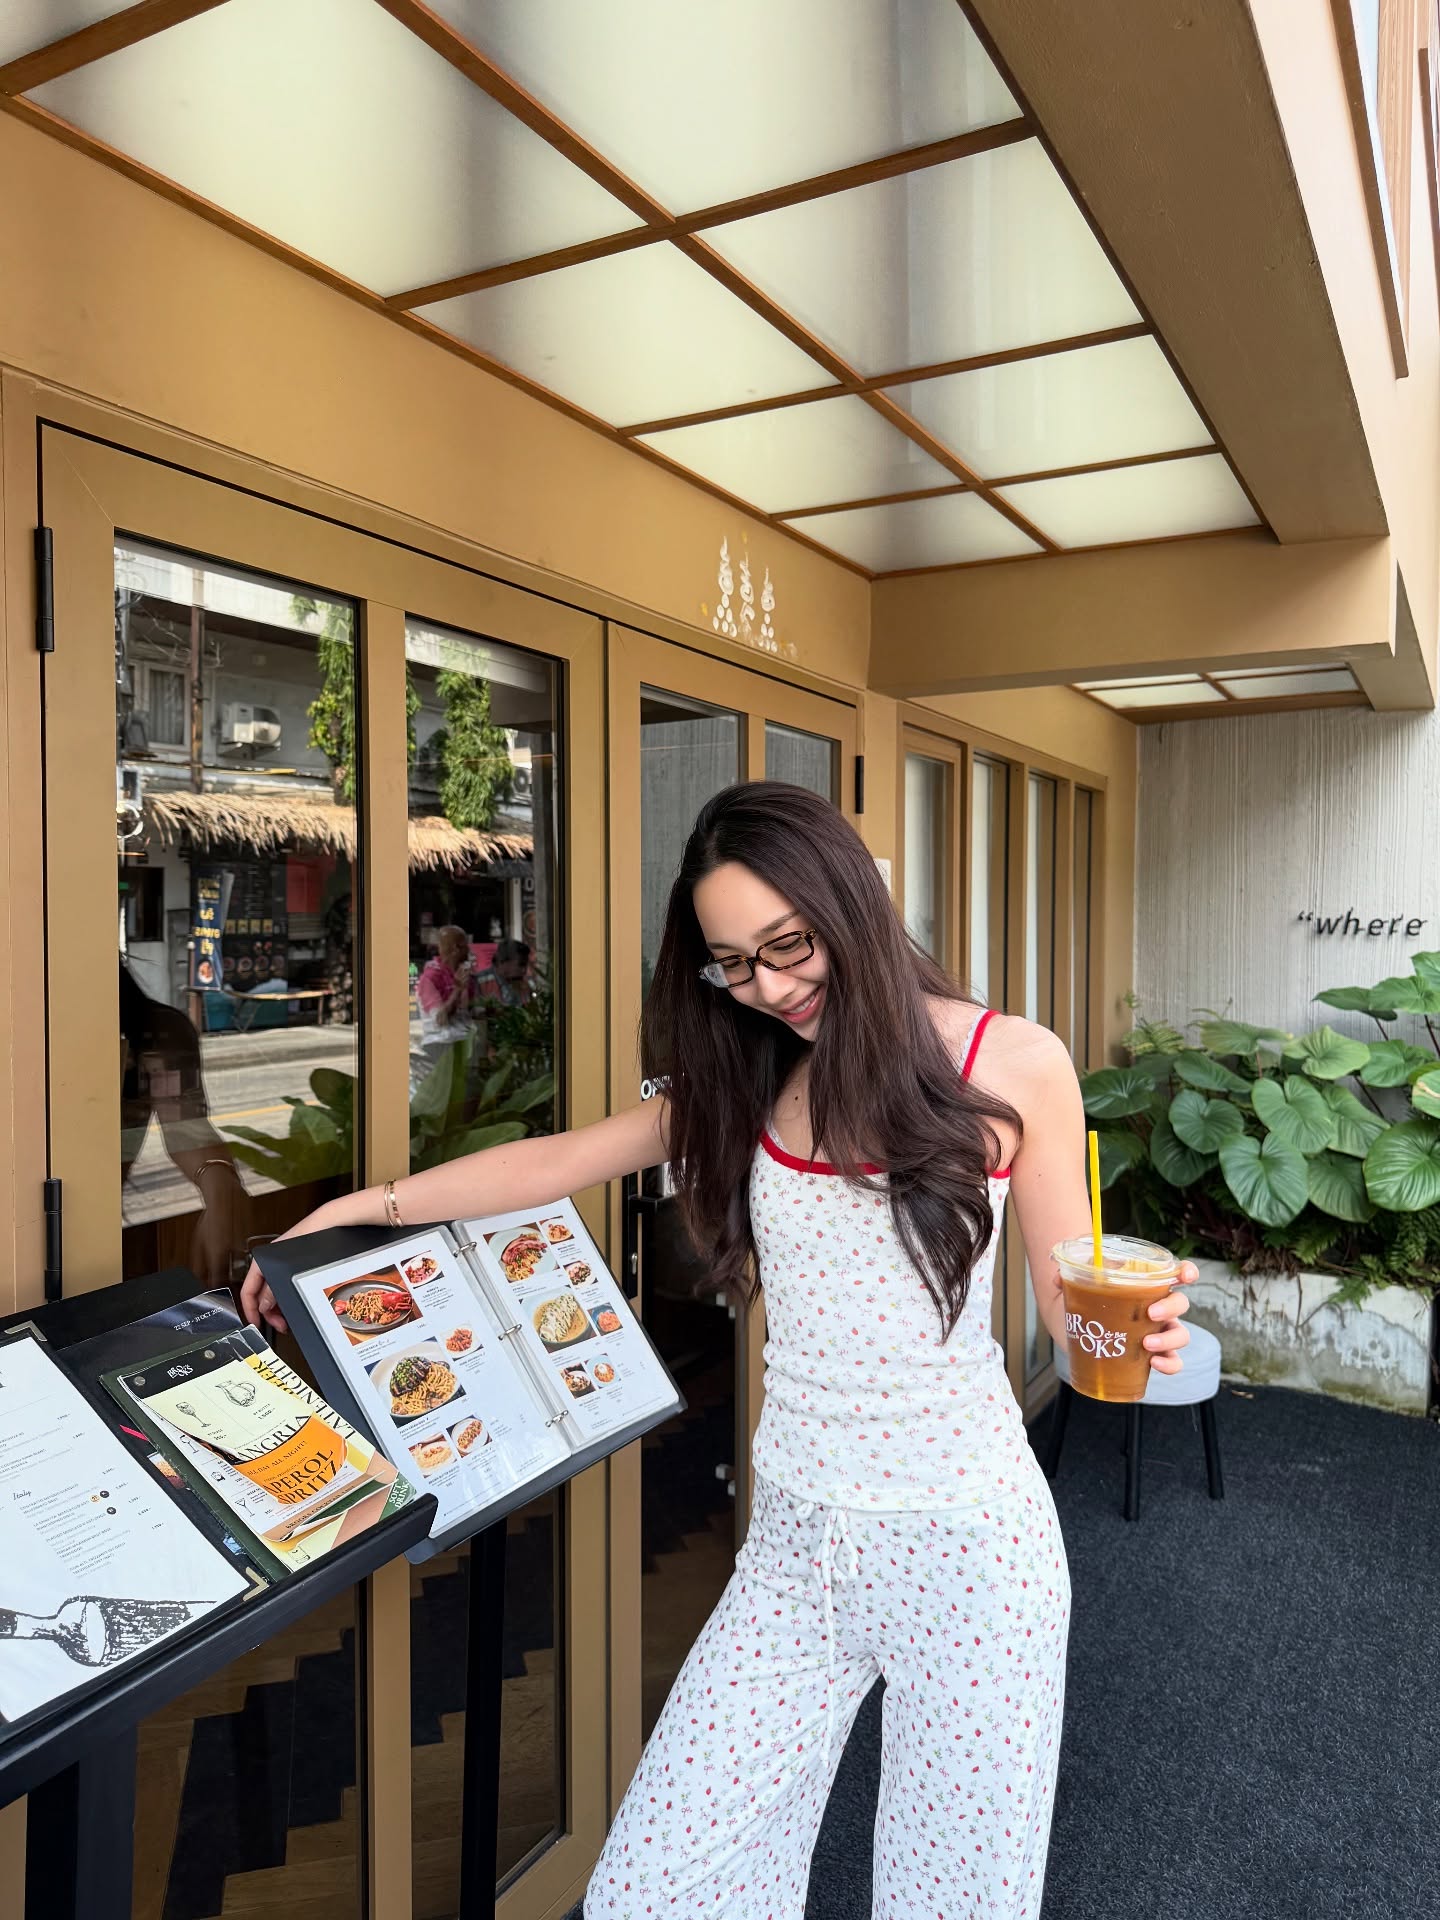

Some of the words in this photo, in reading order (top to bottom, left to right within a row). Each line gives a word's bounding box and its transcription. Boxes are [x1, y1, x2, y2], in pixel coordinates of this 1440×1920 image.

[180, 1319, 192, 1329] SEP
[199, 1310, 212, 1320] OCT
[236, 1415, 311, 1460] ANGRIA
[271, 1457, 285, 1467] ALL
[12, 1489, 32, 1501] Italy
[388, 1483, 402, 1504] SOFT
